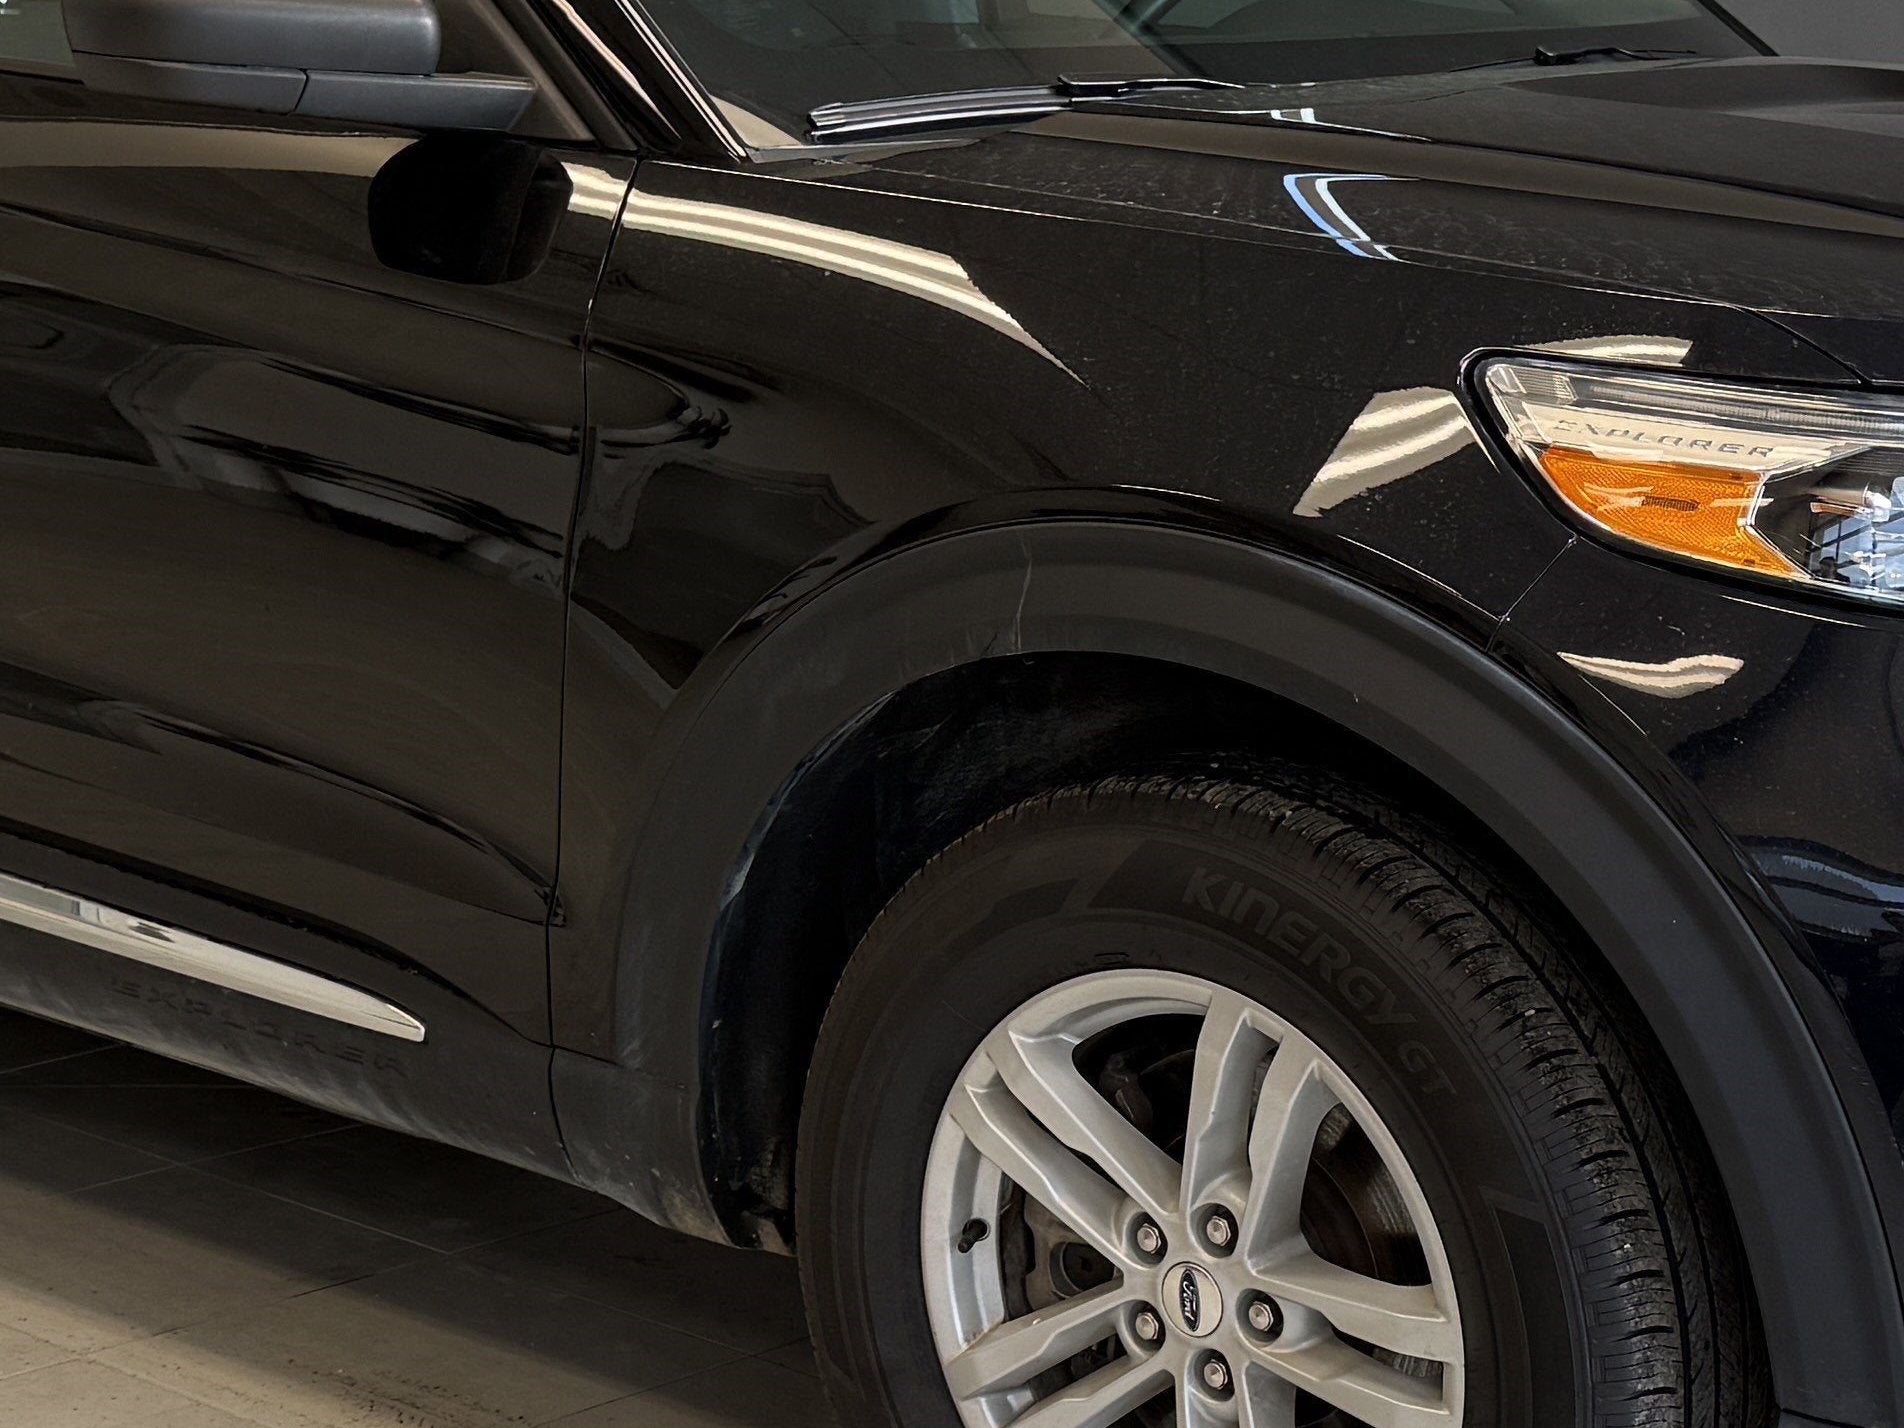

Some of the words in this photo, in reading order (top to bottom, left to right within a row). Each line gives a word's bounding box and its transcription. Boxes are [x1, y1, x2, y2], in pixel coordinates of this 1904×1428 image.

[1552, 418, 1776, 460] EXPLORER
[110, 976, 410, 1079] EXPLORER
[1181, 866, 1418, 1027] KINERGY
[1397, 1040, 1459, 1097] GT
